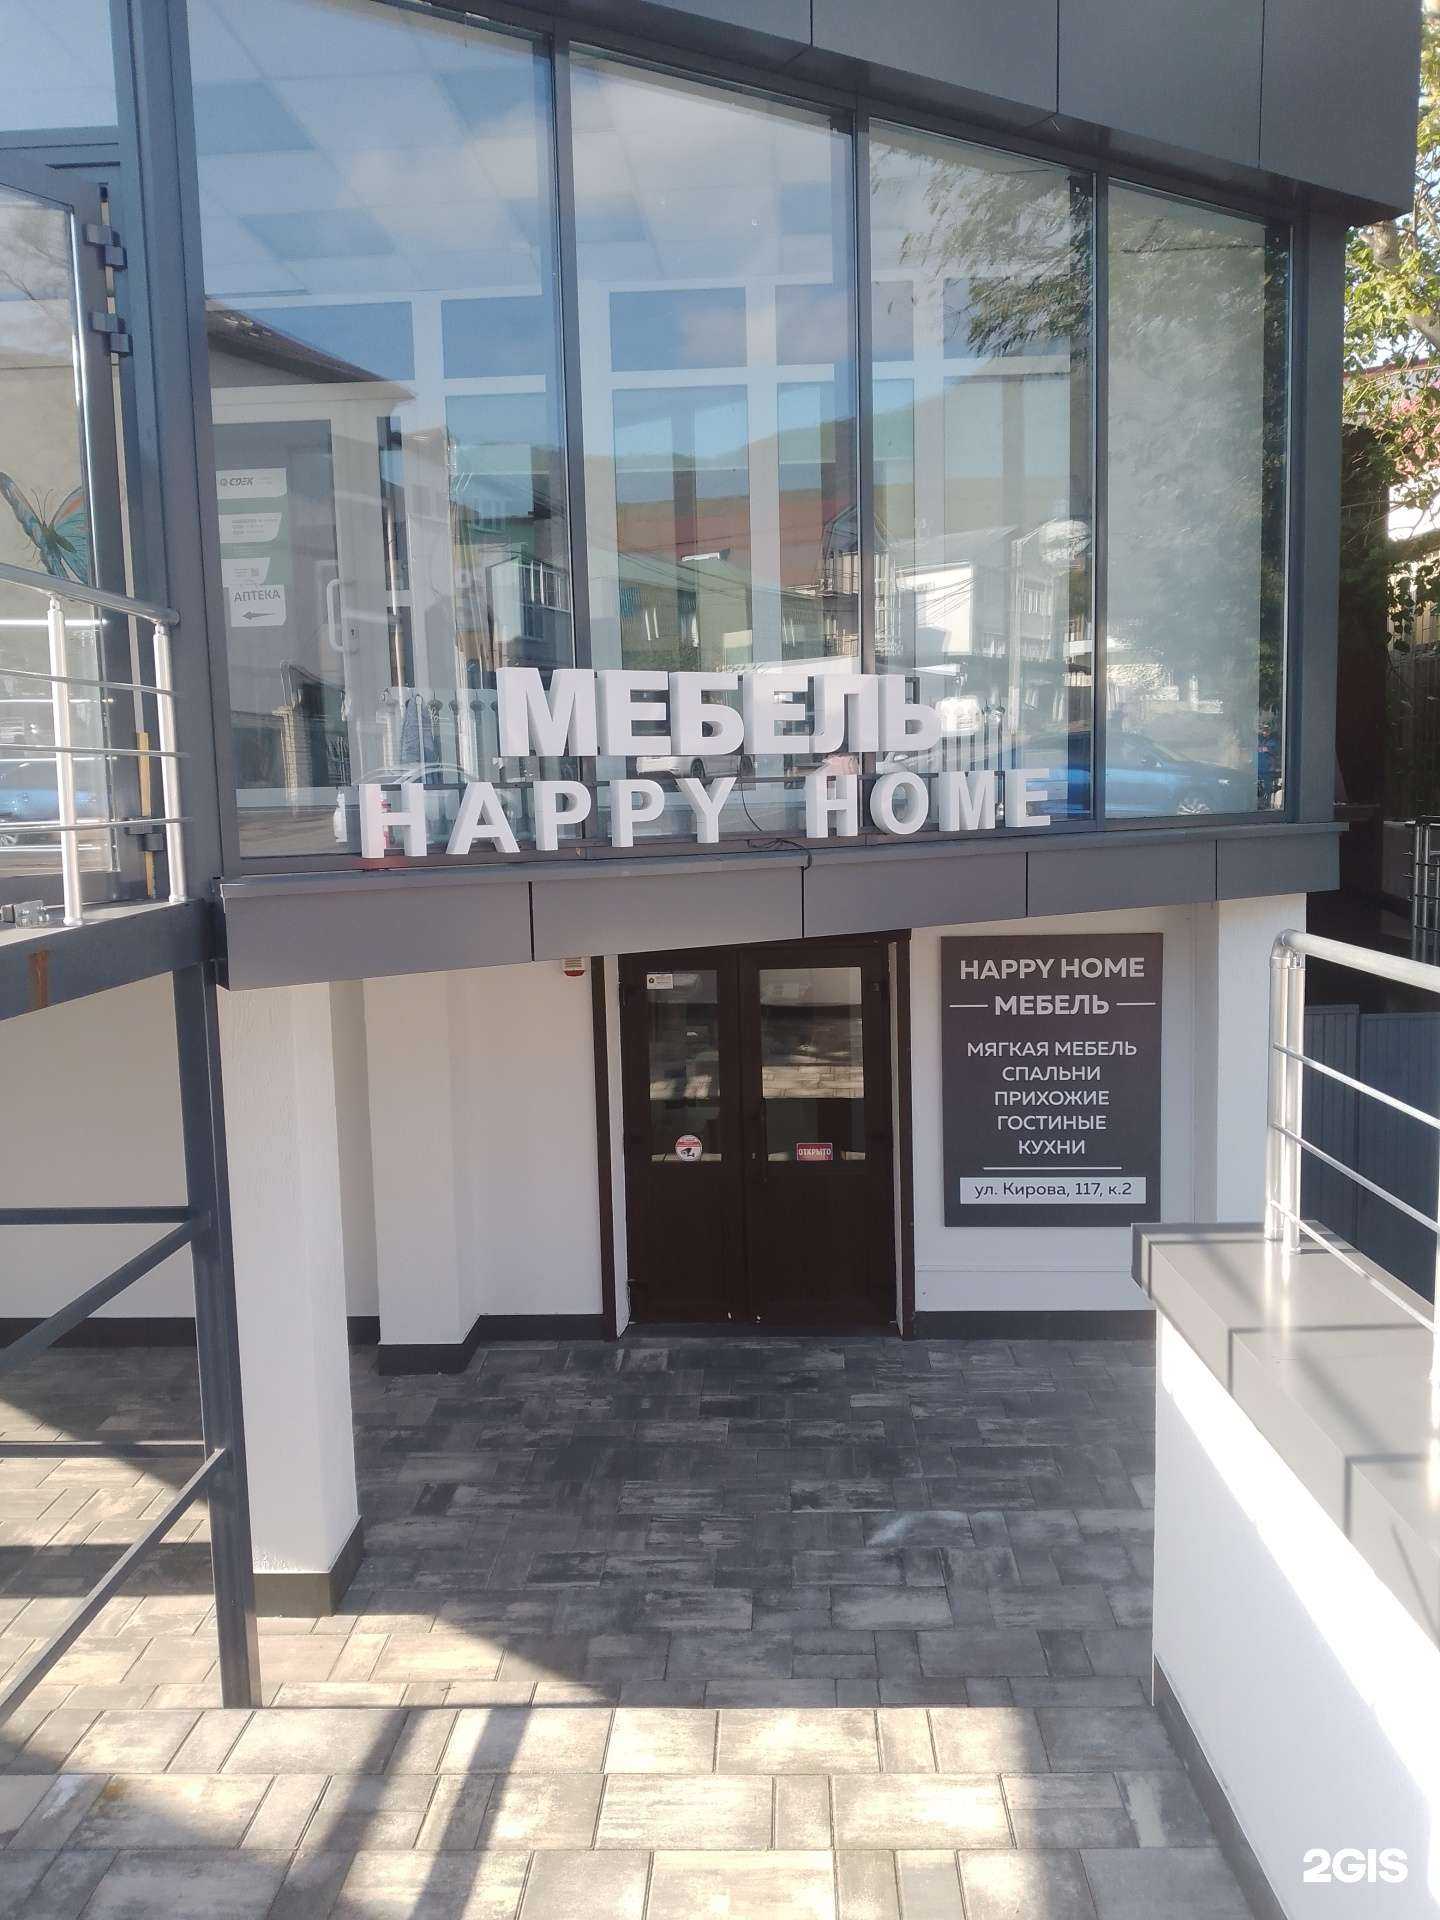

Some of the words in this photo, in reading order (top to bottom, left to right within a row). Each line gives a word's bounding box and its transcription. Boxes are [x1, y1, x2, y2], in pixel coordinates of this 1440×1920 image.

[233, 588, 281, 602] АПТЕКА
[496, 667, 942, 757] МЕБЕЛЬ
[358, 776, 738, 859] HAPPY
[804, 767, 1051, 839] HOME
[960, 958, 1055, 980] HAPPY
[1060, 957, 1145, 978] HOME
[995, 994, 1110, 1016] МЕБЕЛЬ
[967, 1041, 1049, 1057] МЯГКАЯ
[1055, 1041, 1137, 1056] МЕБЕЛЬ
[1002, 1066, 1101, 1082] СПАЛЬНИ
[994, 1090, 1110, 1106] ПРИХОЖИЕ
[997, 1115, 1107, 1130] ГОСТИНЫЕ
[798, 1148, 832, 1156] ОТКРЫТО
[1018, 1140, 1086, 1154] КУХНИ
[974, 1184, 997, 1197] ул.
[1003, 1182, 1070, 1199] Кирова,
[1075, 1182, 1103, 1197] 117,
[1108, 1182, 1132, 1195] к.2
